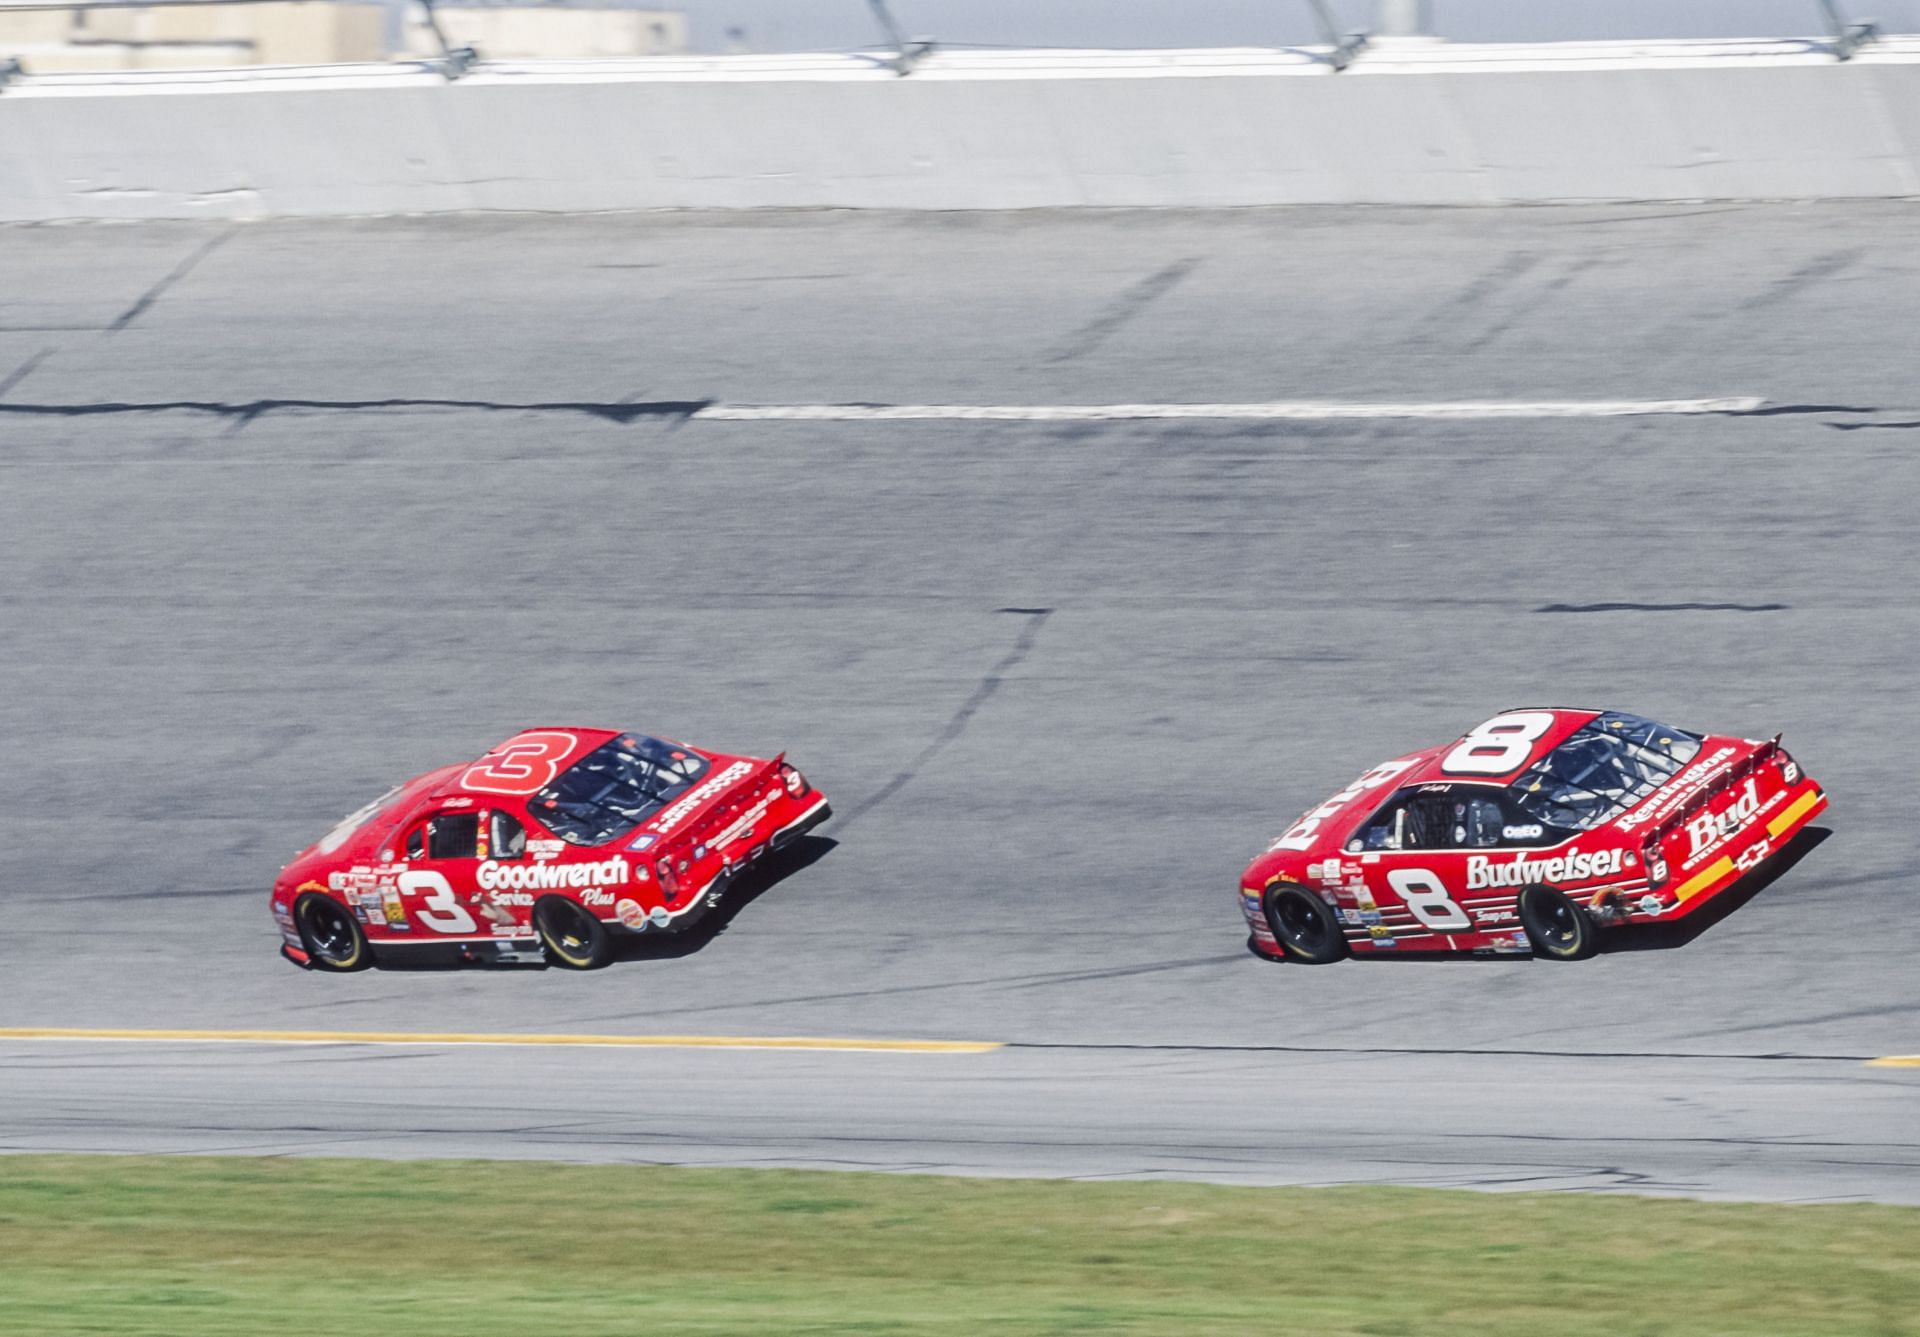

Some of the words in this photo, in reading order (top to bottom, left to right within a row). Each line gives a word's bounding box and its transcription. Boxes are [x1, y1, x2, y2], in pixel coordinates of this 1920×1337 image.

[461, 731, 577, 795] 3
[1441, 712, 1555, 775] 8
[1783, 762, 1798, 783] 8
[1267, 757, 1422, 851] Bud
[1613, 747, 1736, 832] Remington
[1684, 778, 1760, 858] Bud
[477, 856, 628, 890] Goodwrench
[579, 888, 616, 906] Plus
[1387, 868, 1472, 930] 8
[1466, 847, 1623, 889] Budweiser
[1652, 860, 1668, 882] 8
[397, 870, 478, 934] 3
